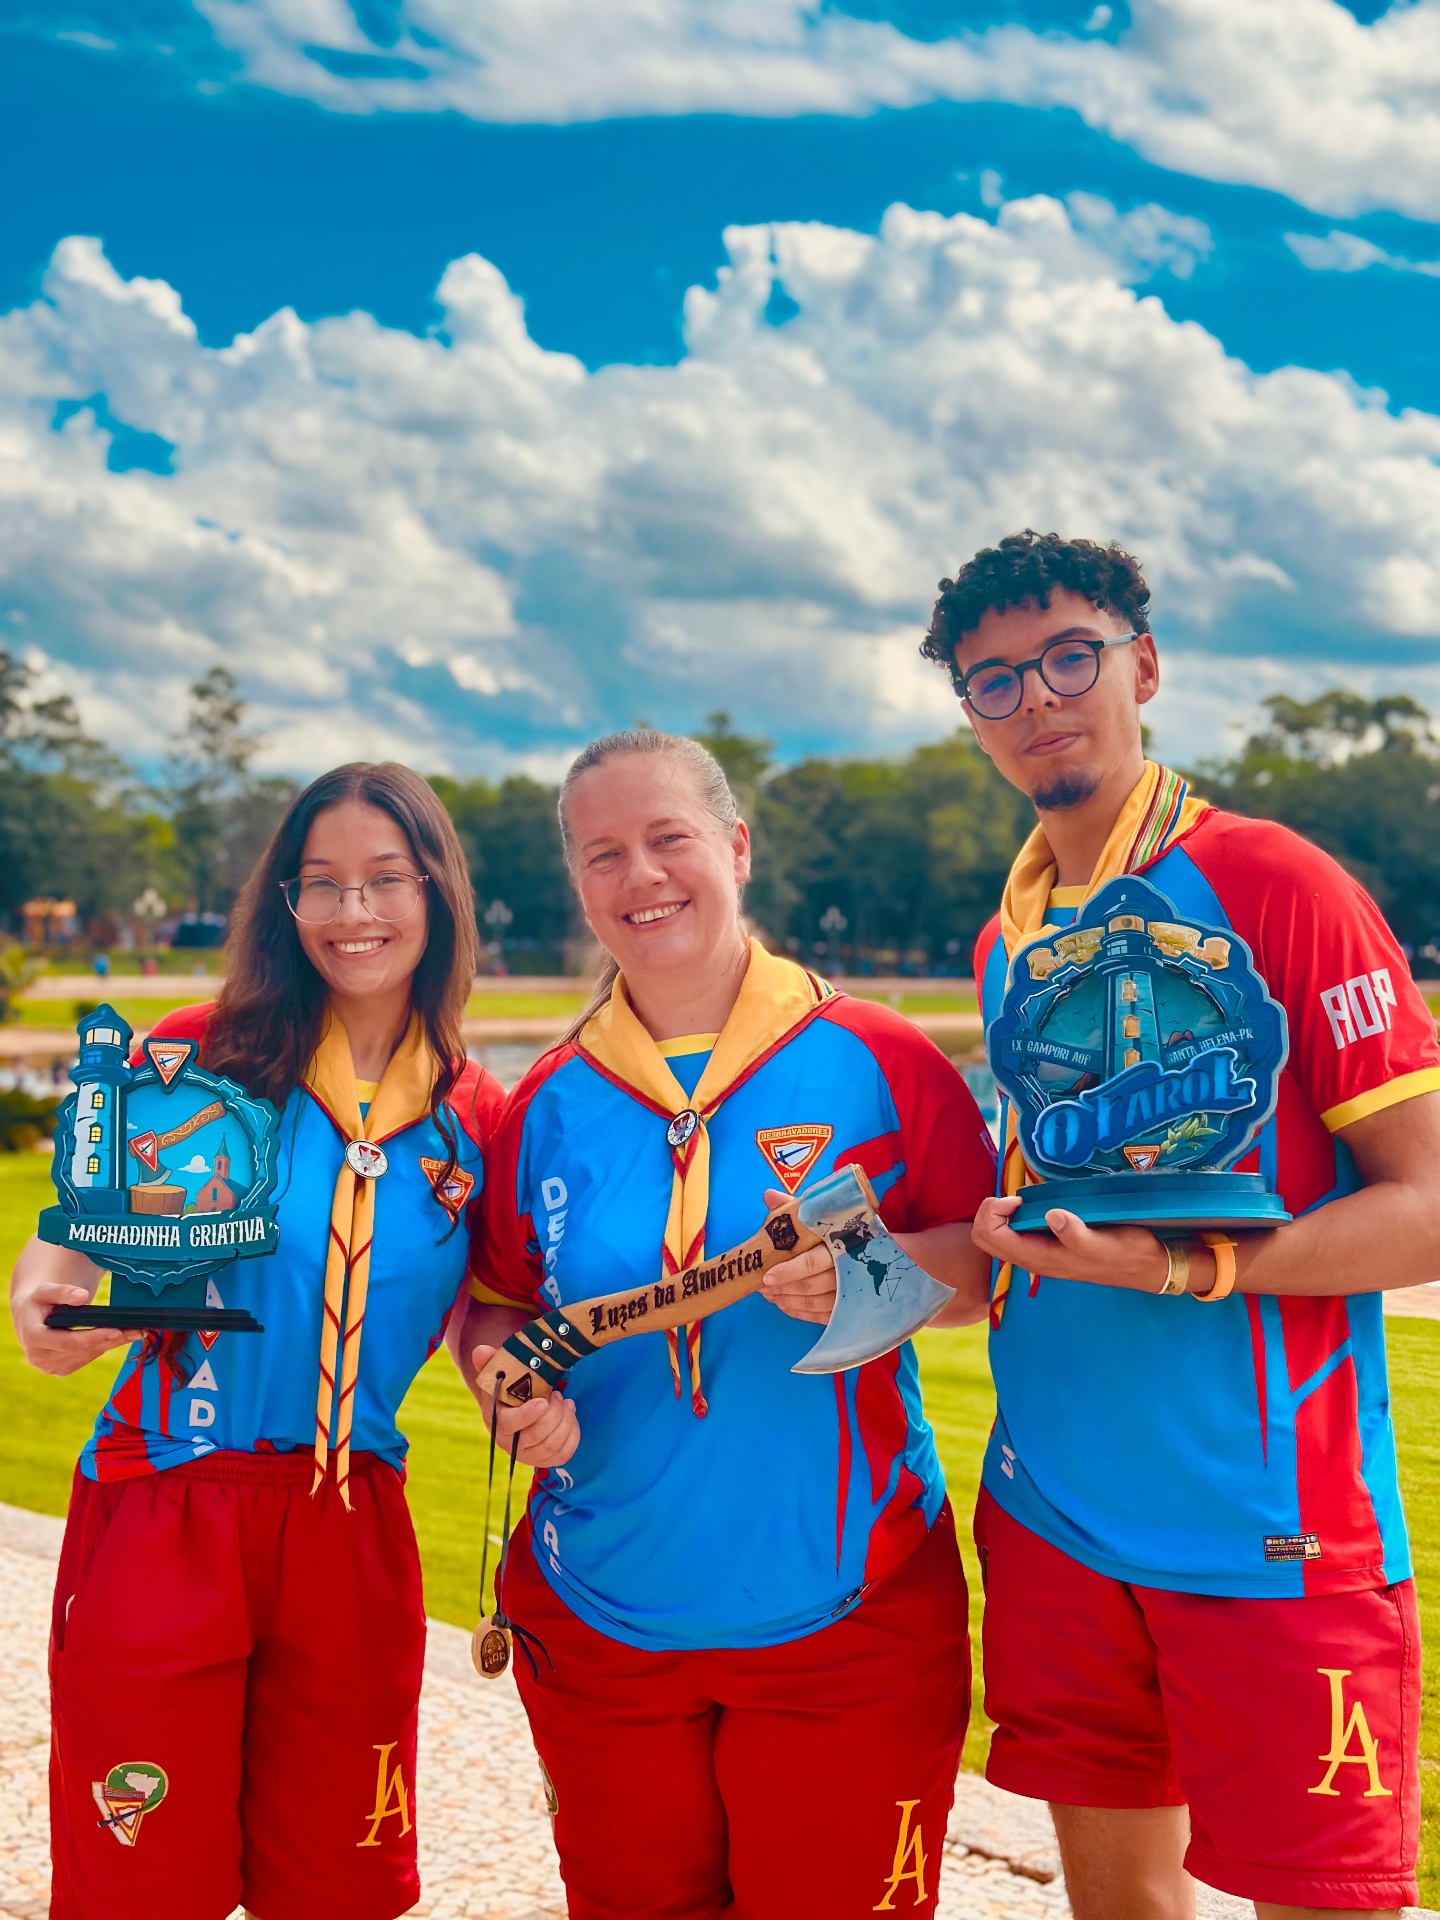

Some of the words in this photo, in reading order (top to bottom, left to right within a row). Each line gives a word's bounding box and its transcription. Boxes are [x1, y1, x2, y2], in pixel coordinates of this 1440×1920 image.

[1320, 968, 1397, 1050] AOP
[1166, 1045, 1197, 1063] SANTA
[69, 1223, 181, 1247] MACHADINHA
[189, 1217, 266, 1247] CRIATIVA
[589, 1293, 648, 1335] Luzes
[654, 1285, 675, 1308] da
[682, 1249, 763, 1299] América
